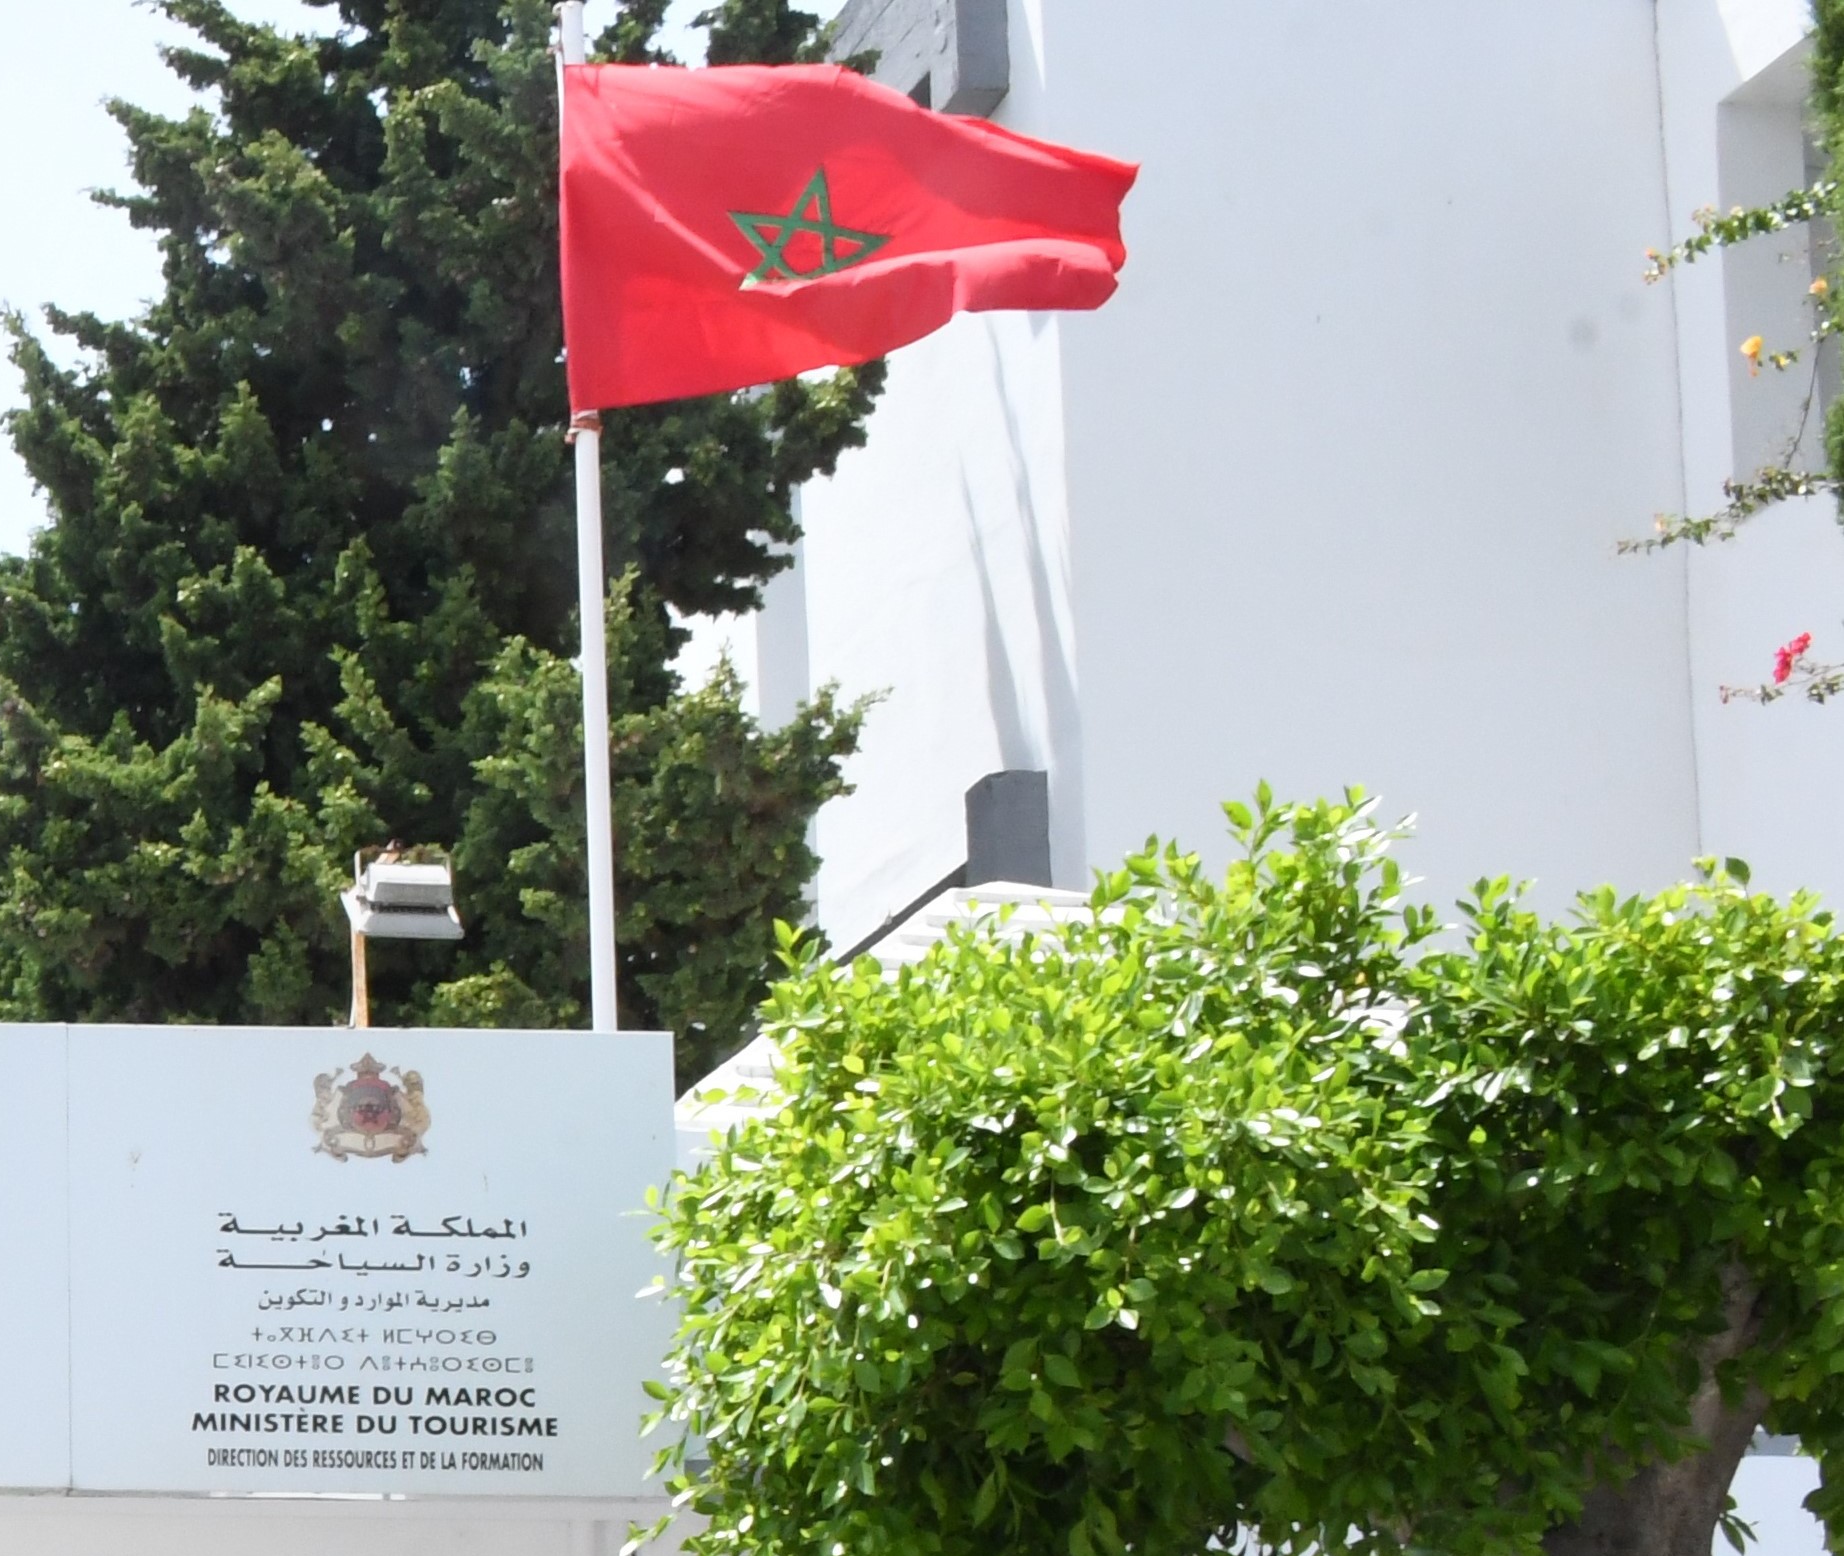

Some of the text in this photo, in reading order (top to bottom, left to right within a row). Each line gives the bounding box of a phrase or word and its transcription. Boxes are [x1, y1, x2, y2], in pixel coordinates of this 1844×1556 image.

[218, 1212, 527, 1242] المملكة المغربية
[216, 1249, 530, 1278] وزارة السياحة
[258, 1288, 490, 1313] مديرية الموارد و التكوين
[215, 1384, 535, 1407] ROYAUME DU MAROC
[192, 1407, 558, 1437] MINISTÈRE DU TOURISME
[208, 1448, 543, 1471] DIRECTION DES RESSOURCES ET DE LA FORMATION
